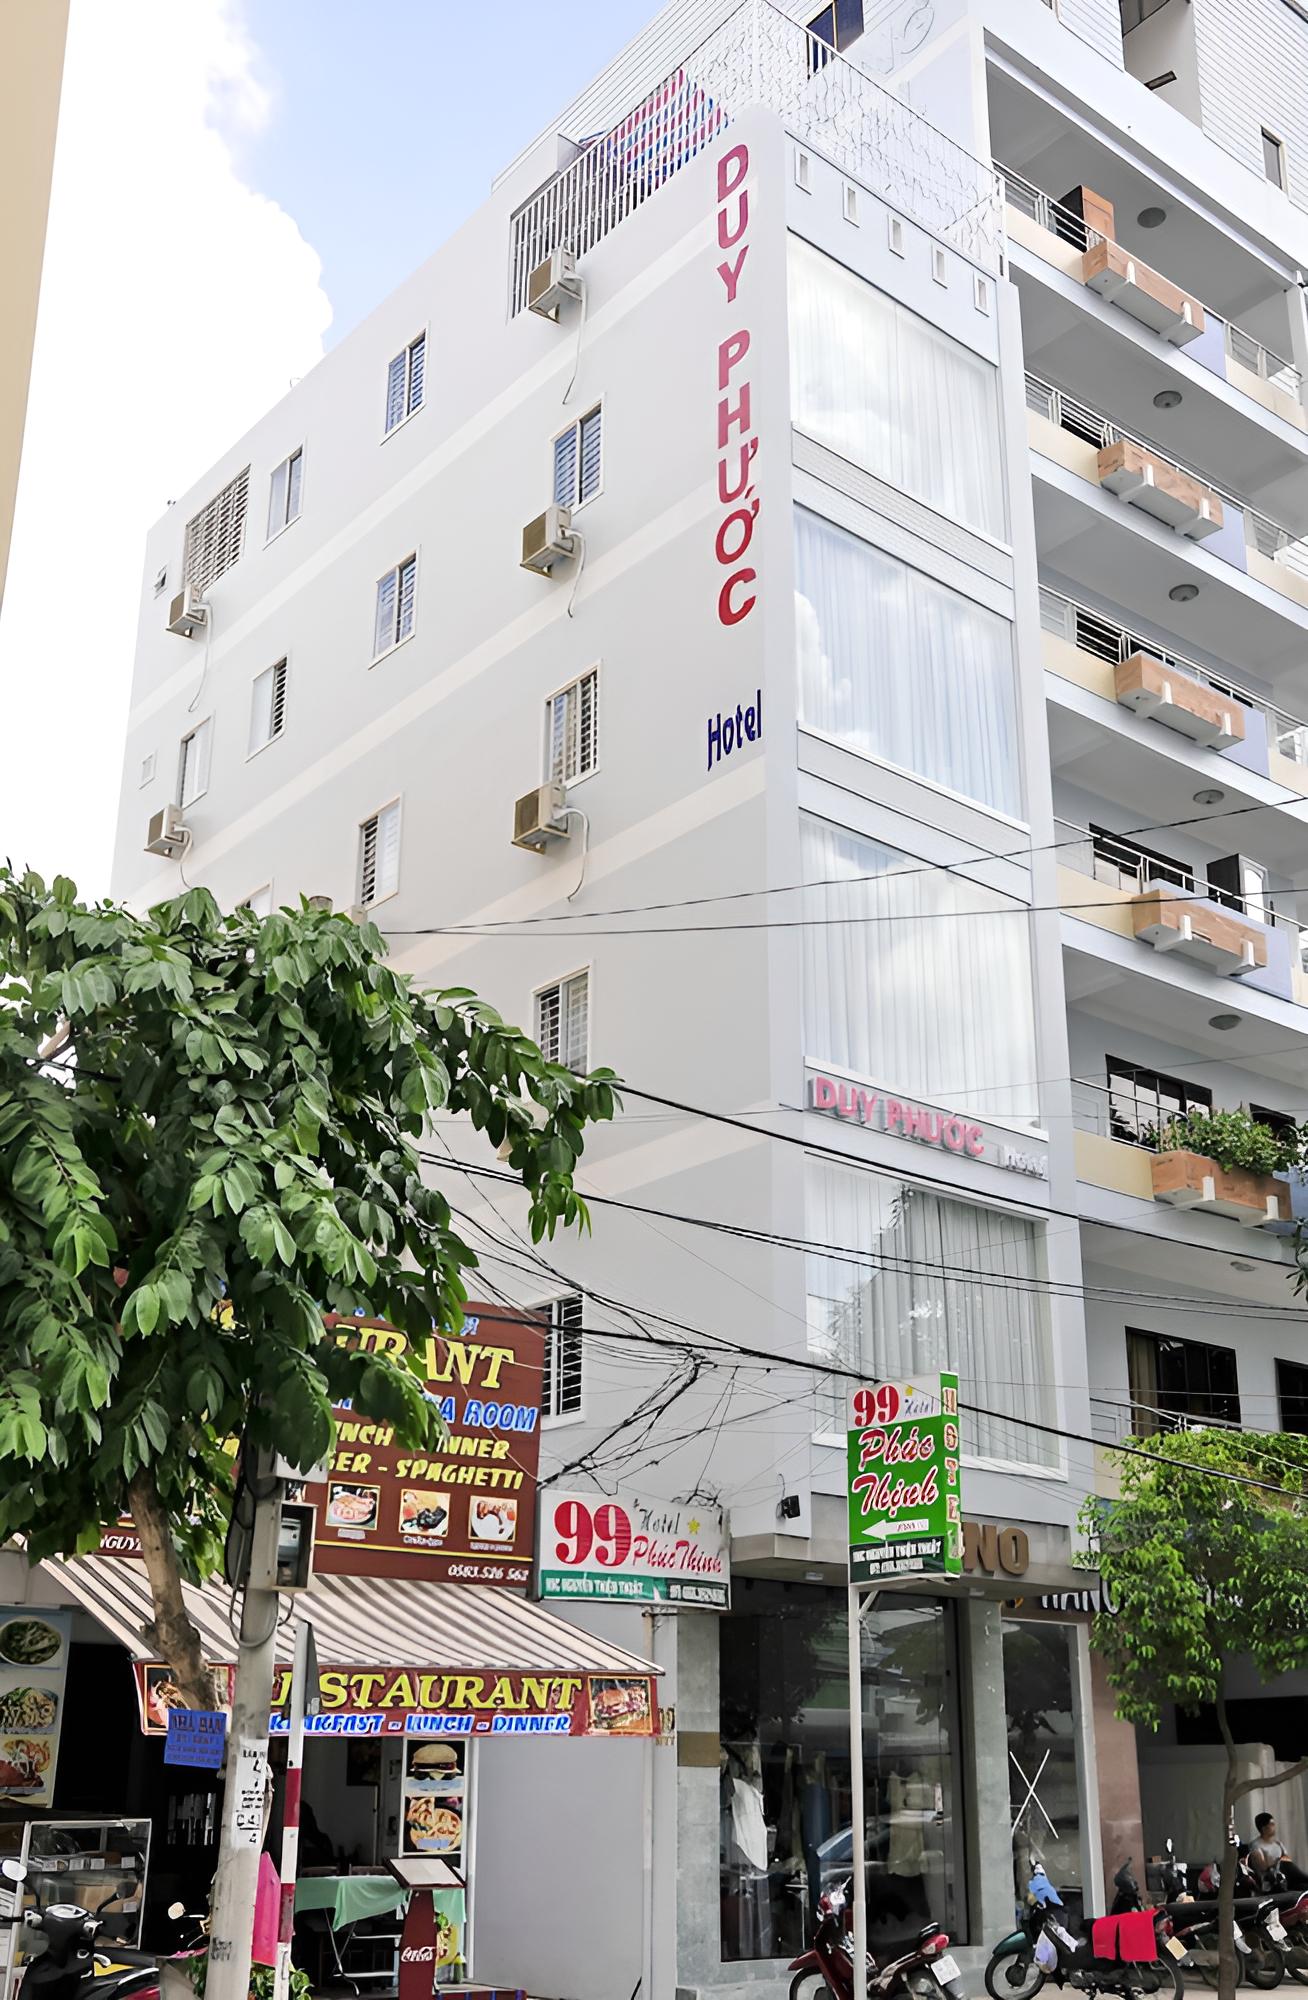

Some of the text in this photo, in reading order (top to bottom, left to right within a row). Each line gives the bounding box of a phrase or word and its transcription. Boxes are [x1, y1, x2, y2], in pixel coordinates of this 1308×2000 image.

[715, 144, 760, 627] DUY PHƯỚC
[706, 688, 762, 772] Hotel
[815, 1076, 878, 1123] DUY
[462, 1398, 539, 1433] ROOM
[853, 1384, 900, 1428] 99
[395, 1458, 524, 1490] SPAGHETTI
[554, 1500, 632, 1567] 99
[405, 1714, 475, 1735] LUNCH
[491, 1713, 571, 1734] DINNER
